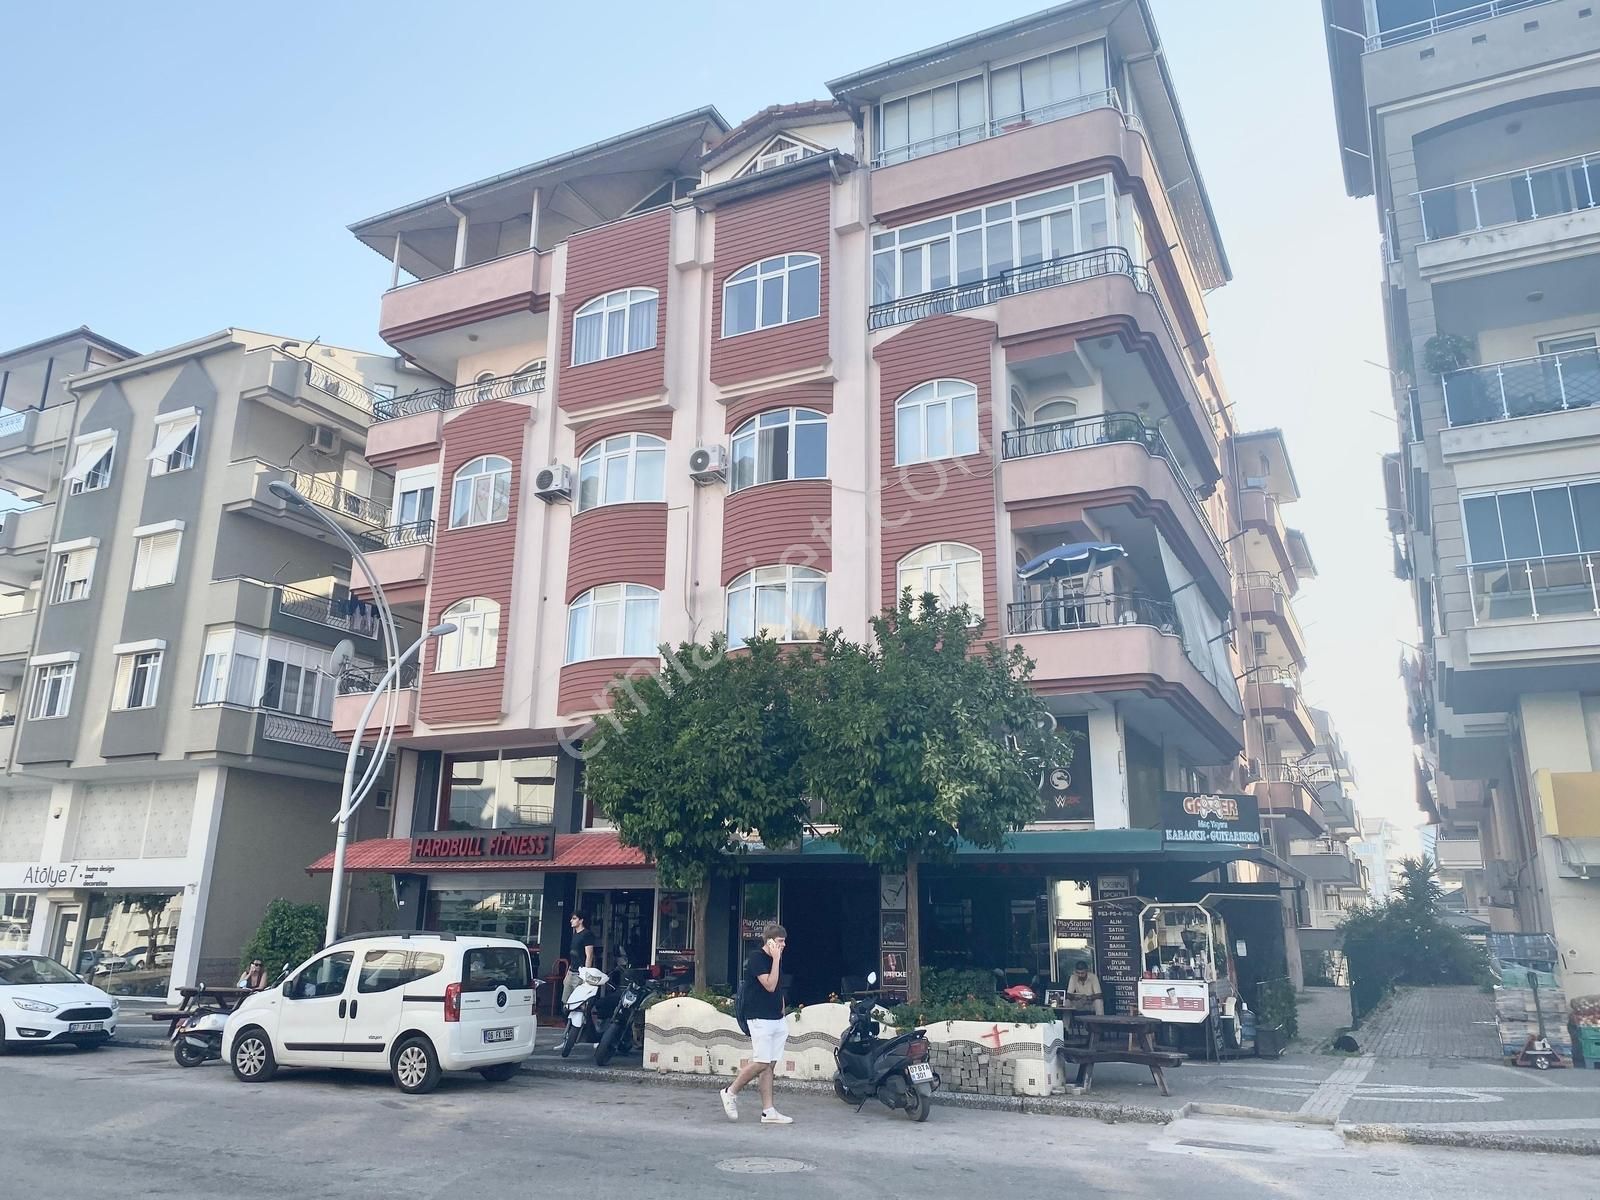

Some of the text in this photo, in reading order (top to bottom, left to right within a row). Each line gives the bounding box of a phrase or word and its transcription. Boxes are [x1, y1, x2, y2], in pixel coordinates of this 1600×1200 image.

[1165, 830, 1206, 841] KARAOKE
[415, 838, 483, 857] HARDBULL
[70, 865, 78, 882] 7
[1057, 920, 1092, 929] PlayStation
